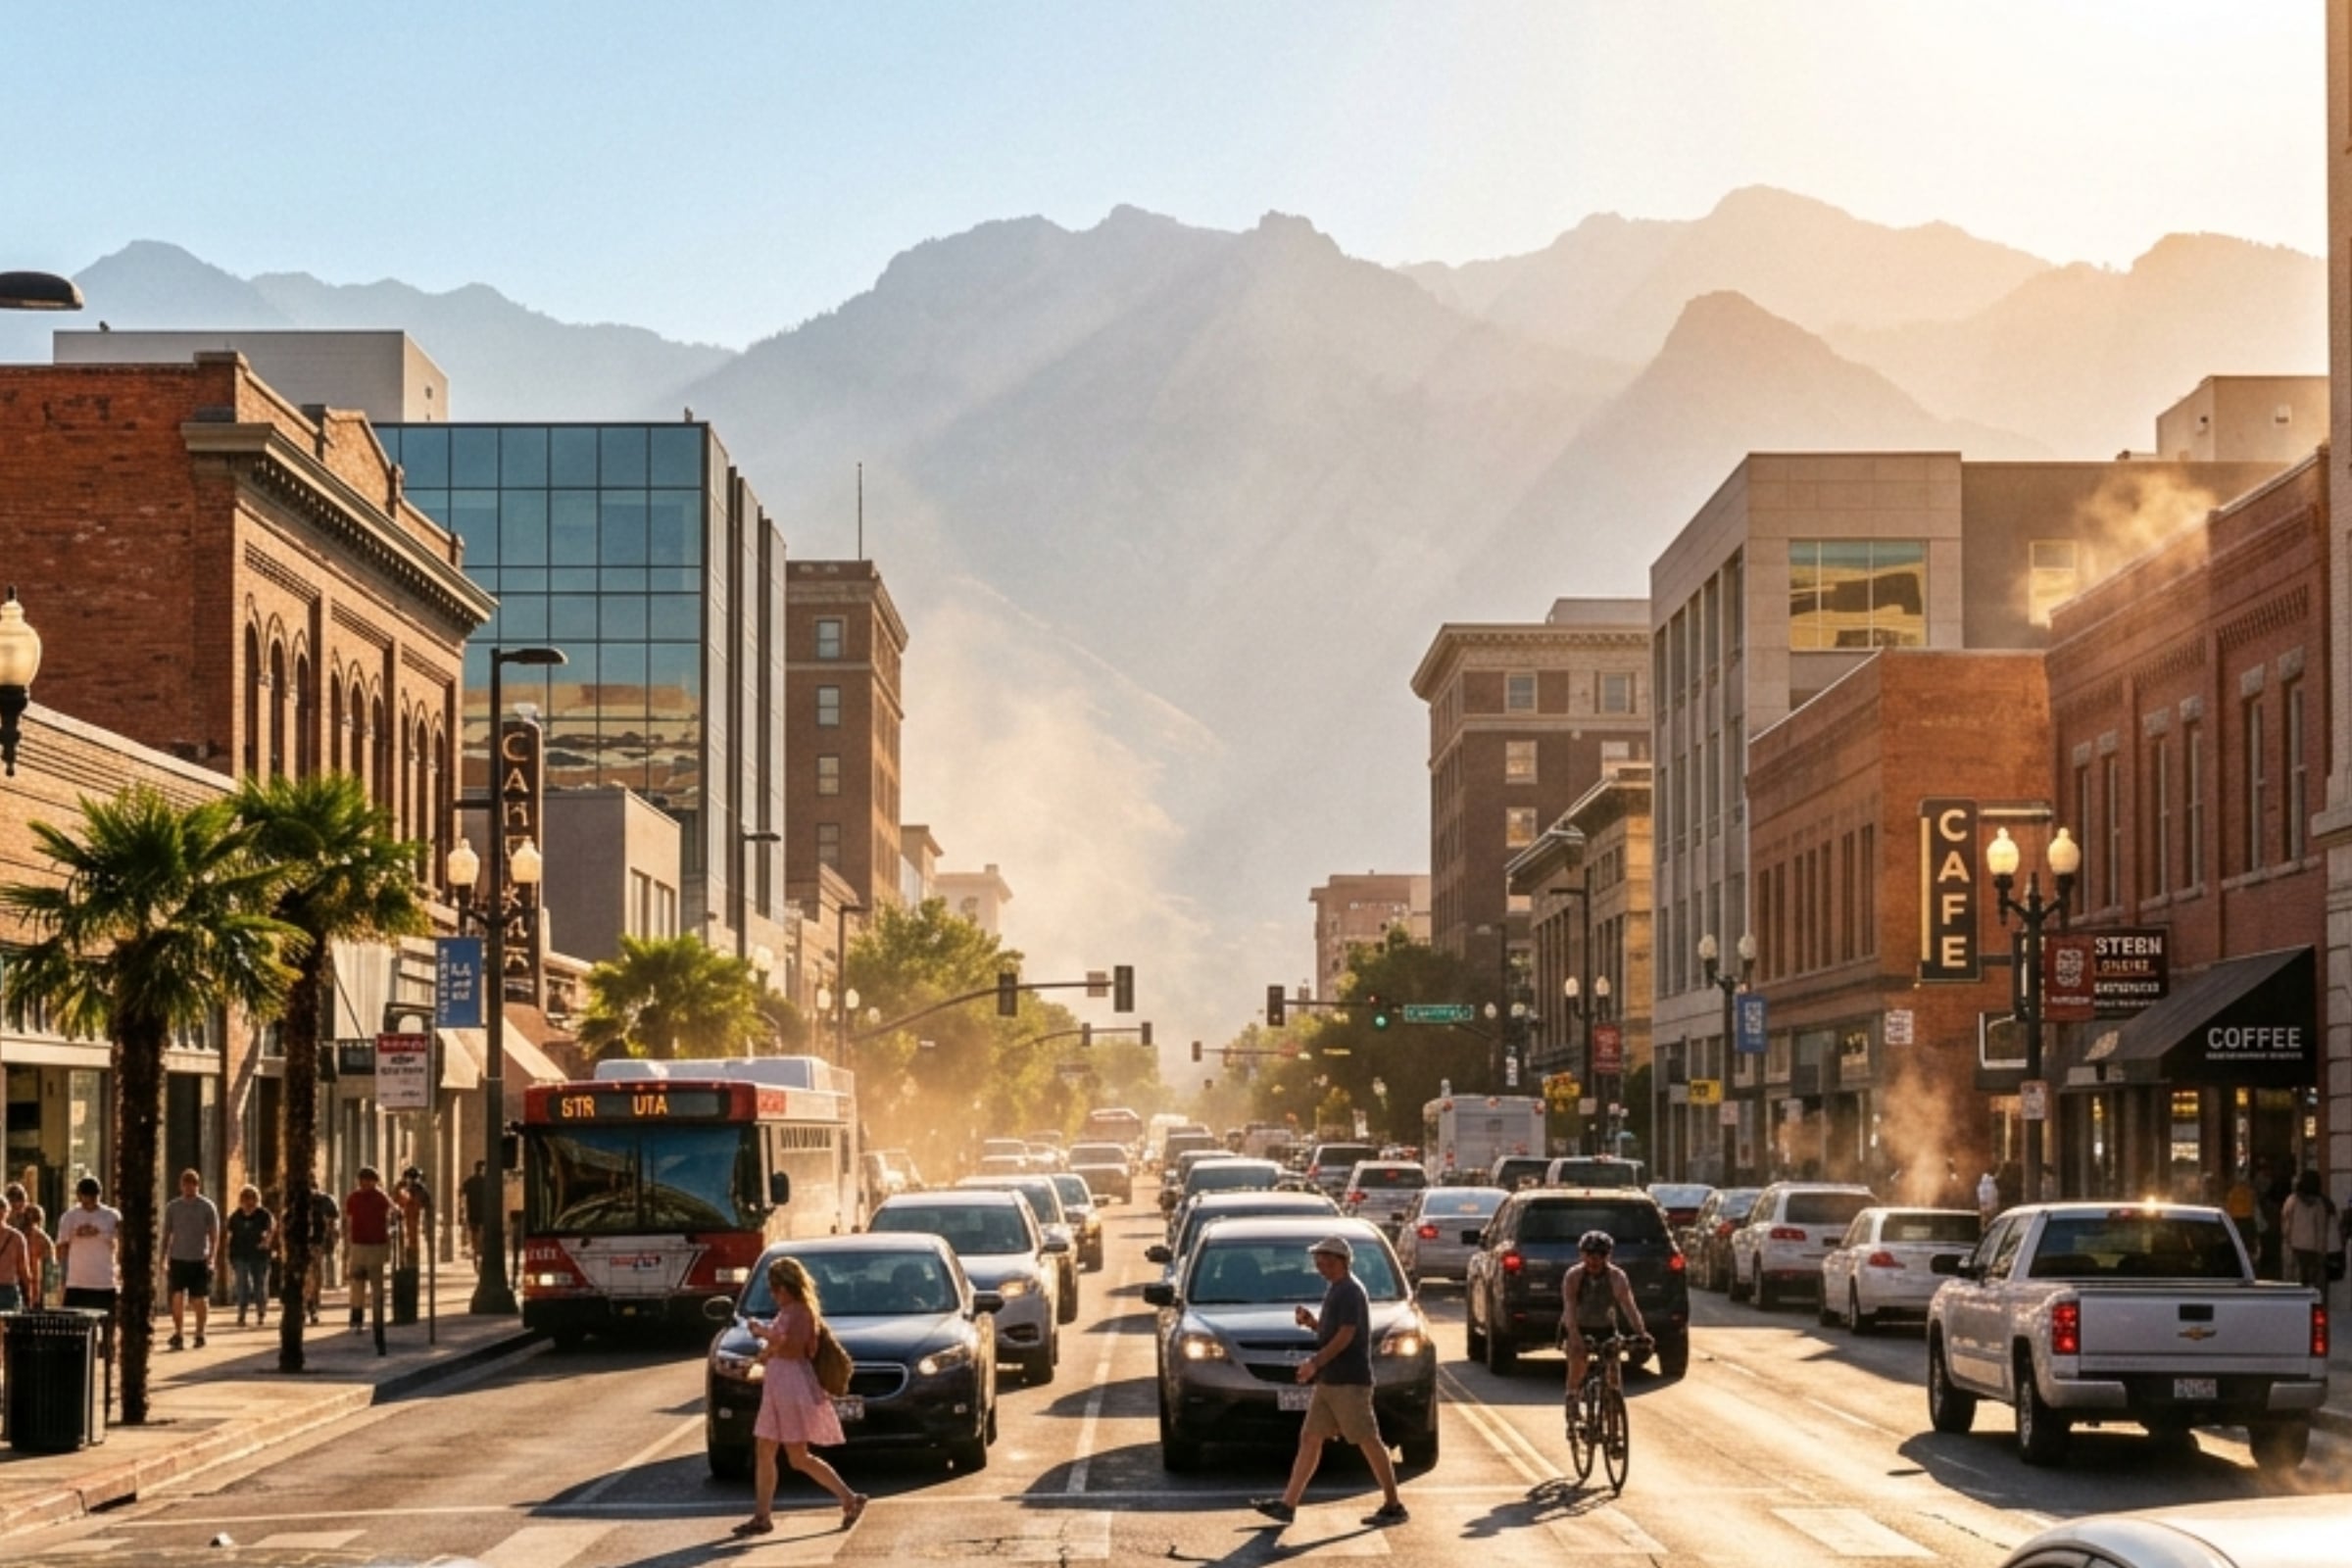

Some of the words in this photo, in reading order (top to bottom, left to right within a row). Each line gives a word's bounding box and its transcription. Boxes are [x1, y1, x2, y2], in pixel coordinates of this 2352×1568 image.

[1937, 808, 1970, 968] CAFE
[2207, 1027, 2302, 1050] COFFEE
[633, 1095, 667, 1116] UTA
